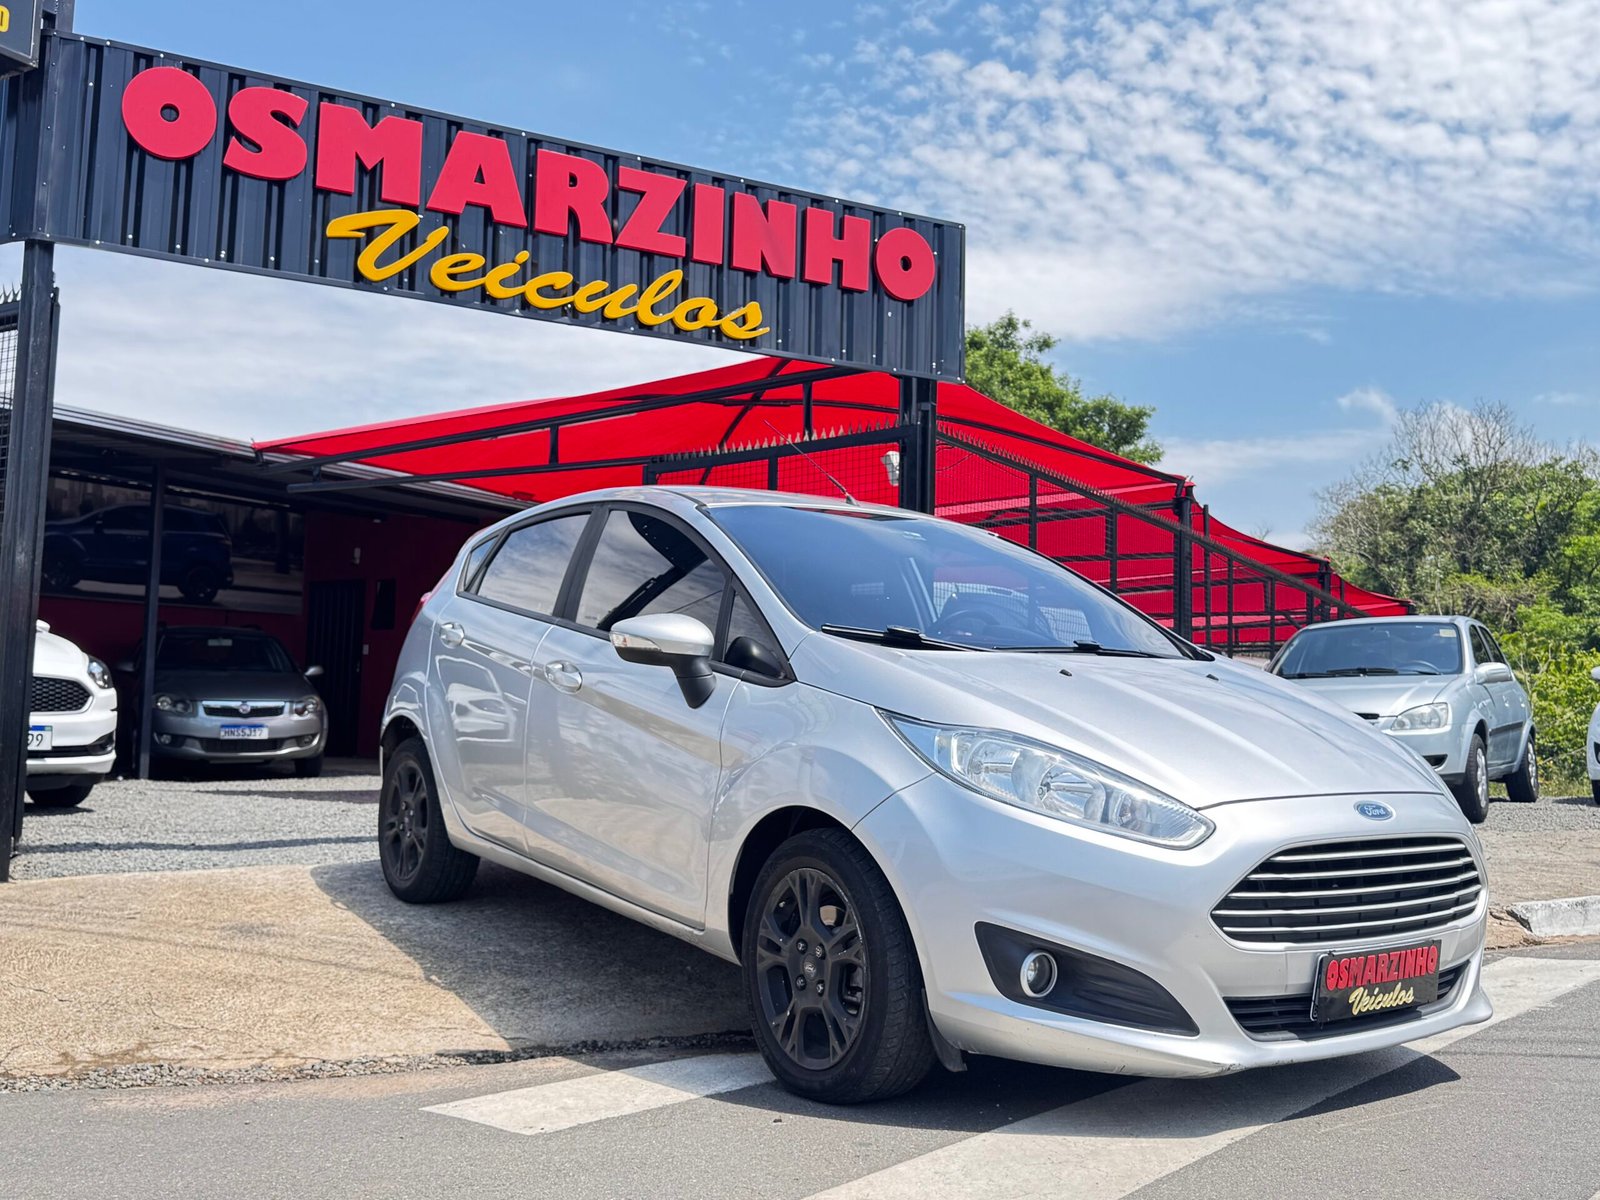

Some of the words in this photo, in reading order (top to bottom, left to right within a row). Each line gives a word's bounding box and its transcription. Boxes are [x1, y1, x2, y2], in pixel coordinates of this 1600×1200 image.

[121, 66, 937, 302] OSMARZINHO
[326, 208, 770, 341] Veiculos
[1325, 945, 1438, 991] OSMARZINHO
[1348, 982, 1415, 1016] Veiculos
